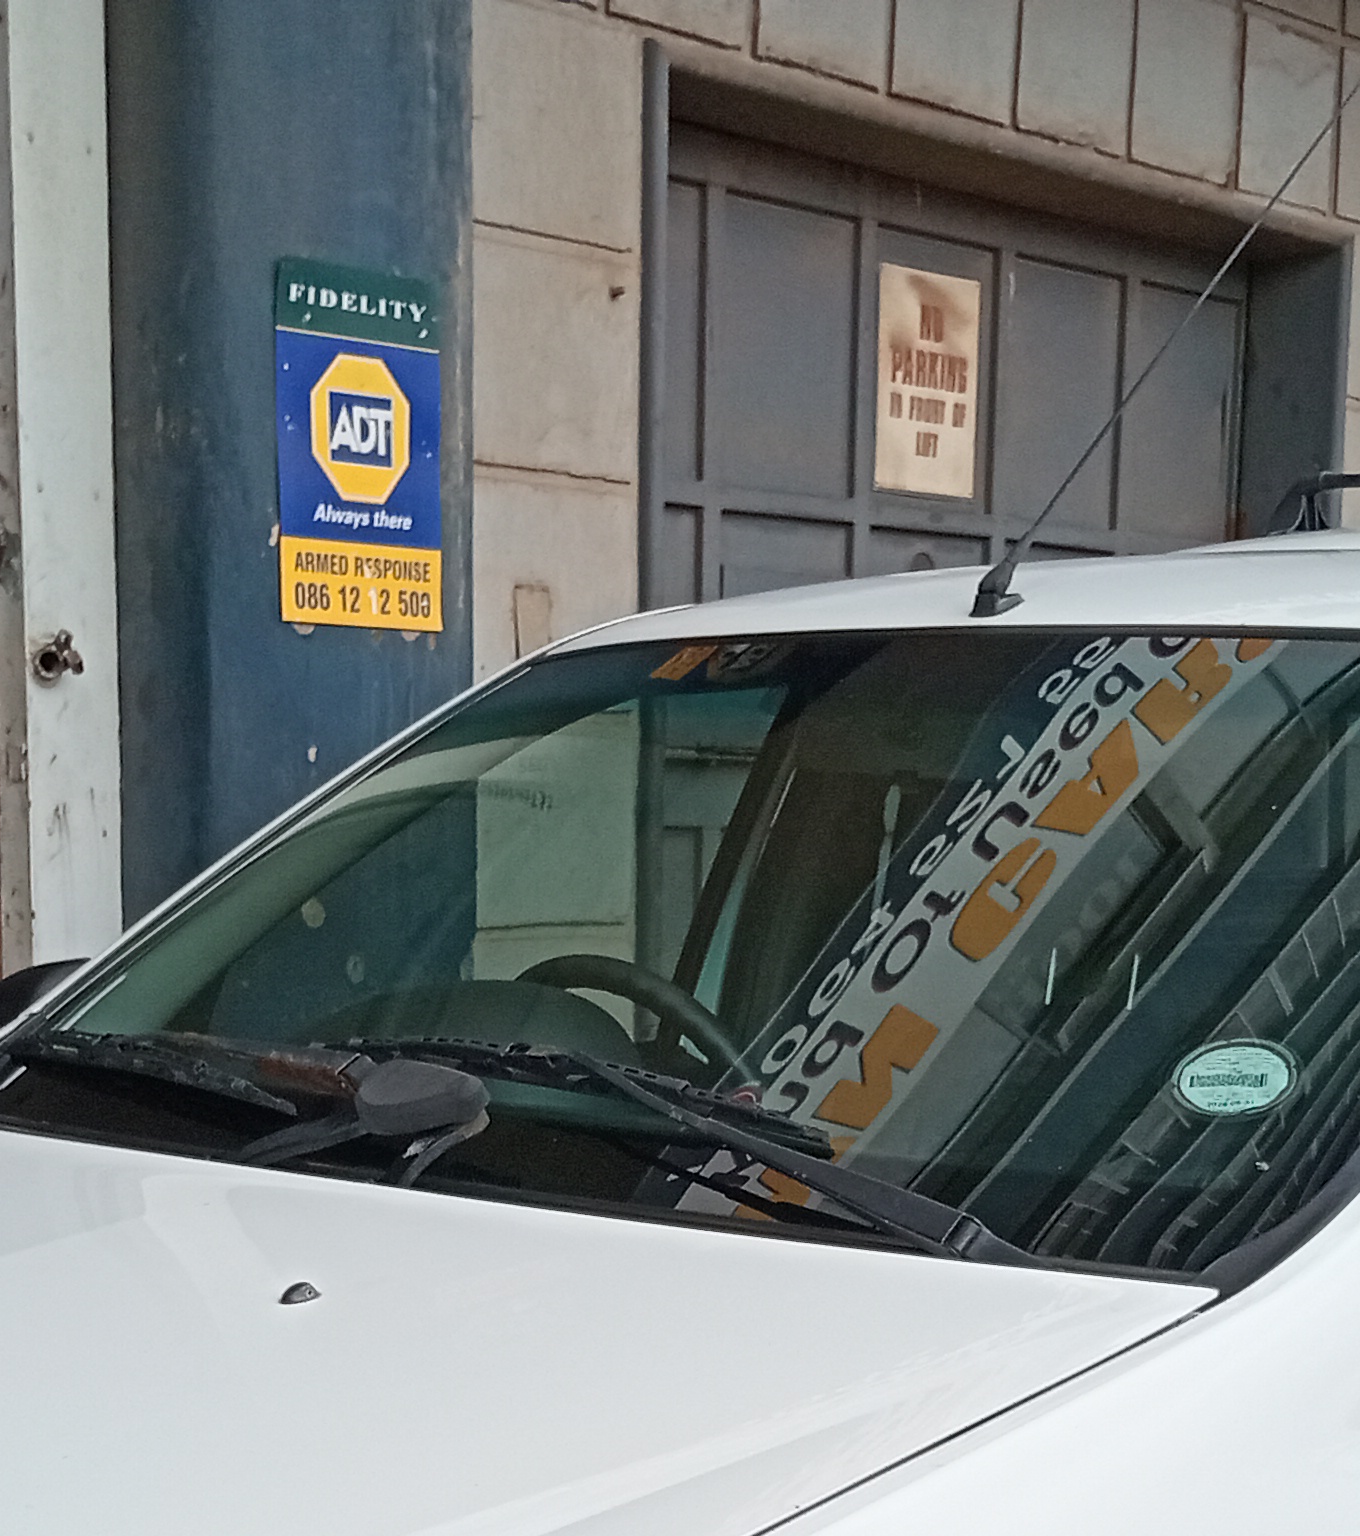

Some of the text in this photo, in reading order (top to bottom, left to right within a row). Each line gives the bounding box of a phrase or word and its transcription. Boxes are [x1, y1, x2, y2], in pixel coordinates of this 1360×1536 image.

[288, 282, 428, 324] FIDELITY
[891, 346, 968, 394] PARKING
[329, 404, 394, 457] ADT
[313, 502, 413, 531] Always there
[295, 551, 431, 584] ARMED RESPONSE
[295, 581, 331, 611] 086
[338, 584, 361, 614] 12
[368, 587, 391, 615] 12
